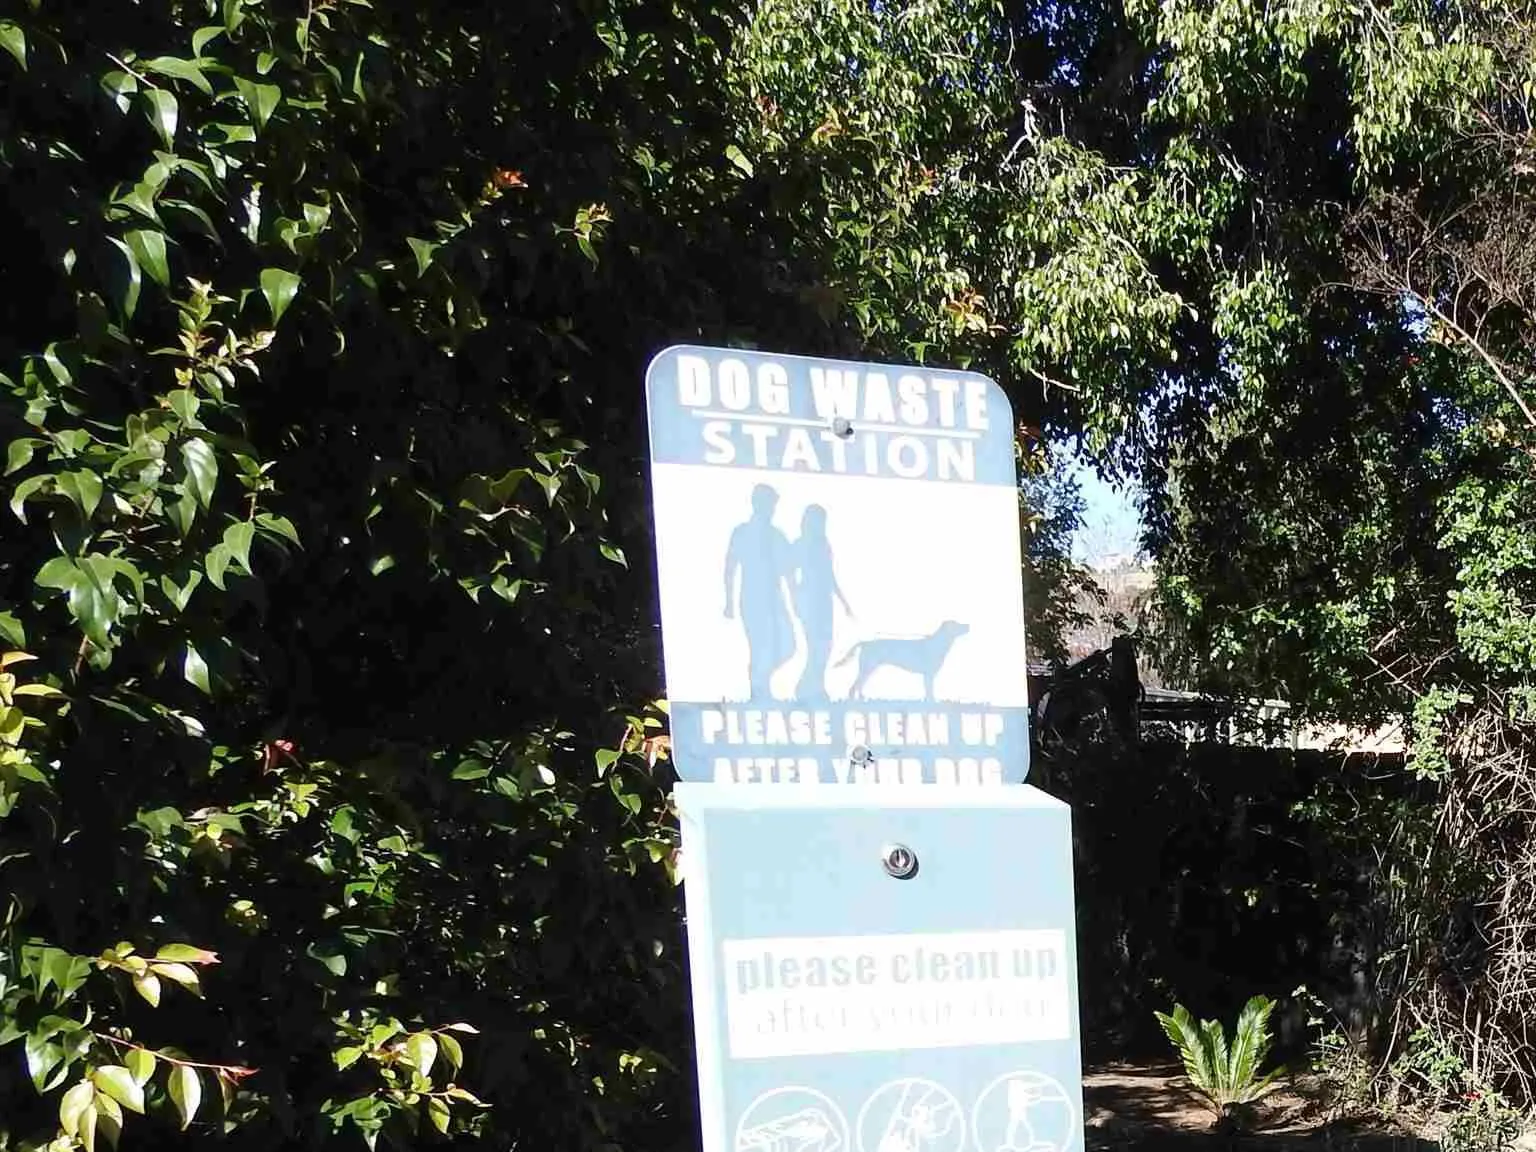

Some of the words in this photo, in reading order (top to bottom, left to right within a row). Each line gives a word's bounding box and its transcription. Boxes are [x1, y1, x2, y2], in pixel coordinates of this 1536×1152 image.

[677, 354, 790, 414] DOG
[810, 366, 990, 430] WASTE
[702, 420, 976, 482] STATION
[701, 708, 833, 746] PLEASE
[844, 711, 949, 746] CLEAN
[960, 713, 1004, 747] UP
[735, 950, 879, 994] please
[891, 946, 1001, 983] clean
[1012, 946, 1057, 982] up
